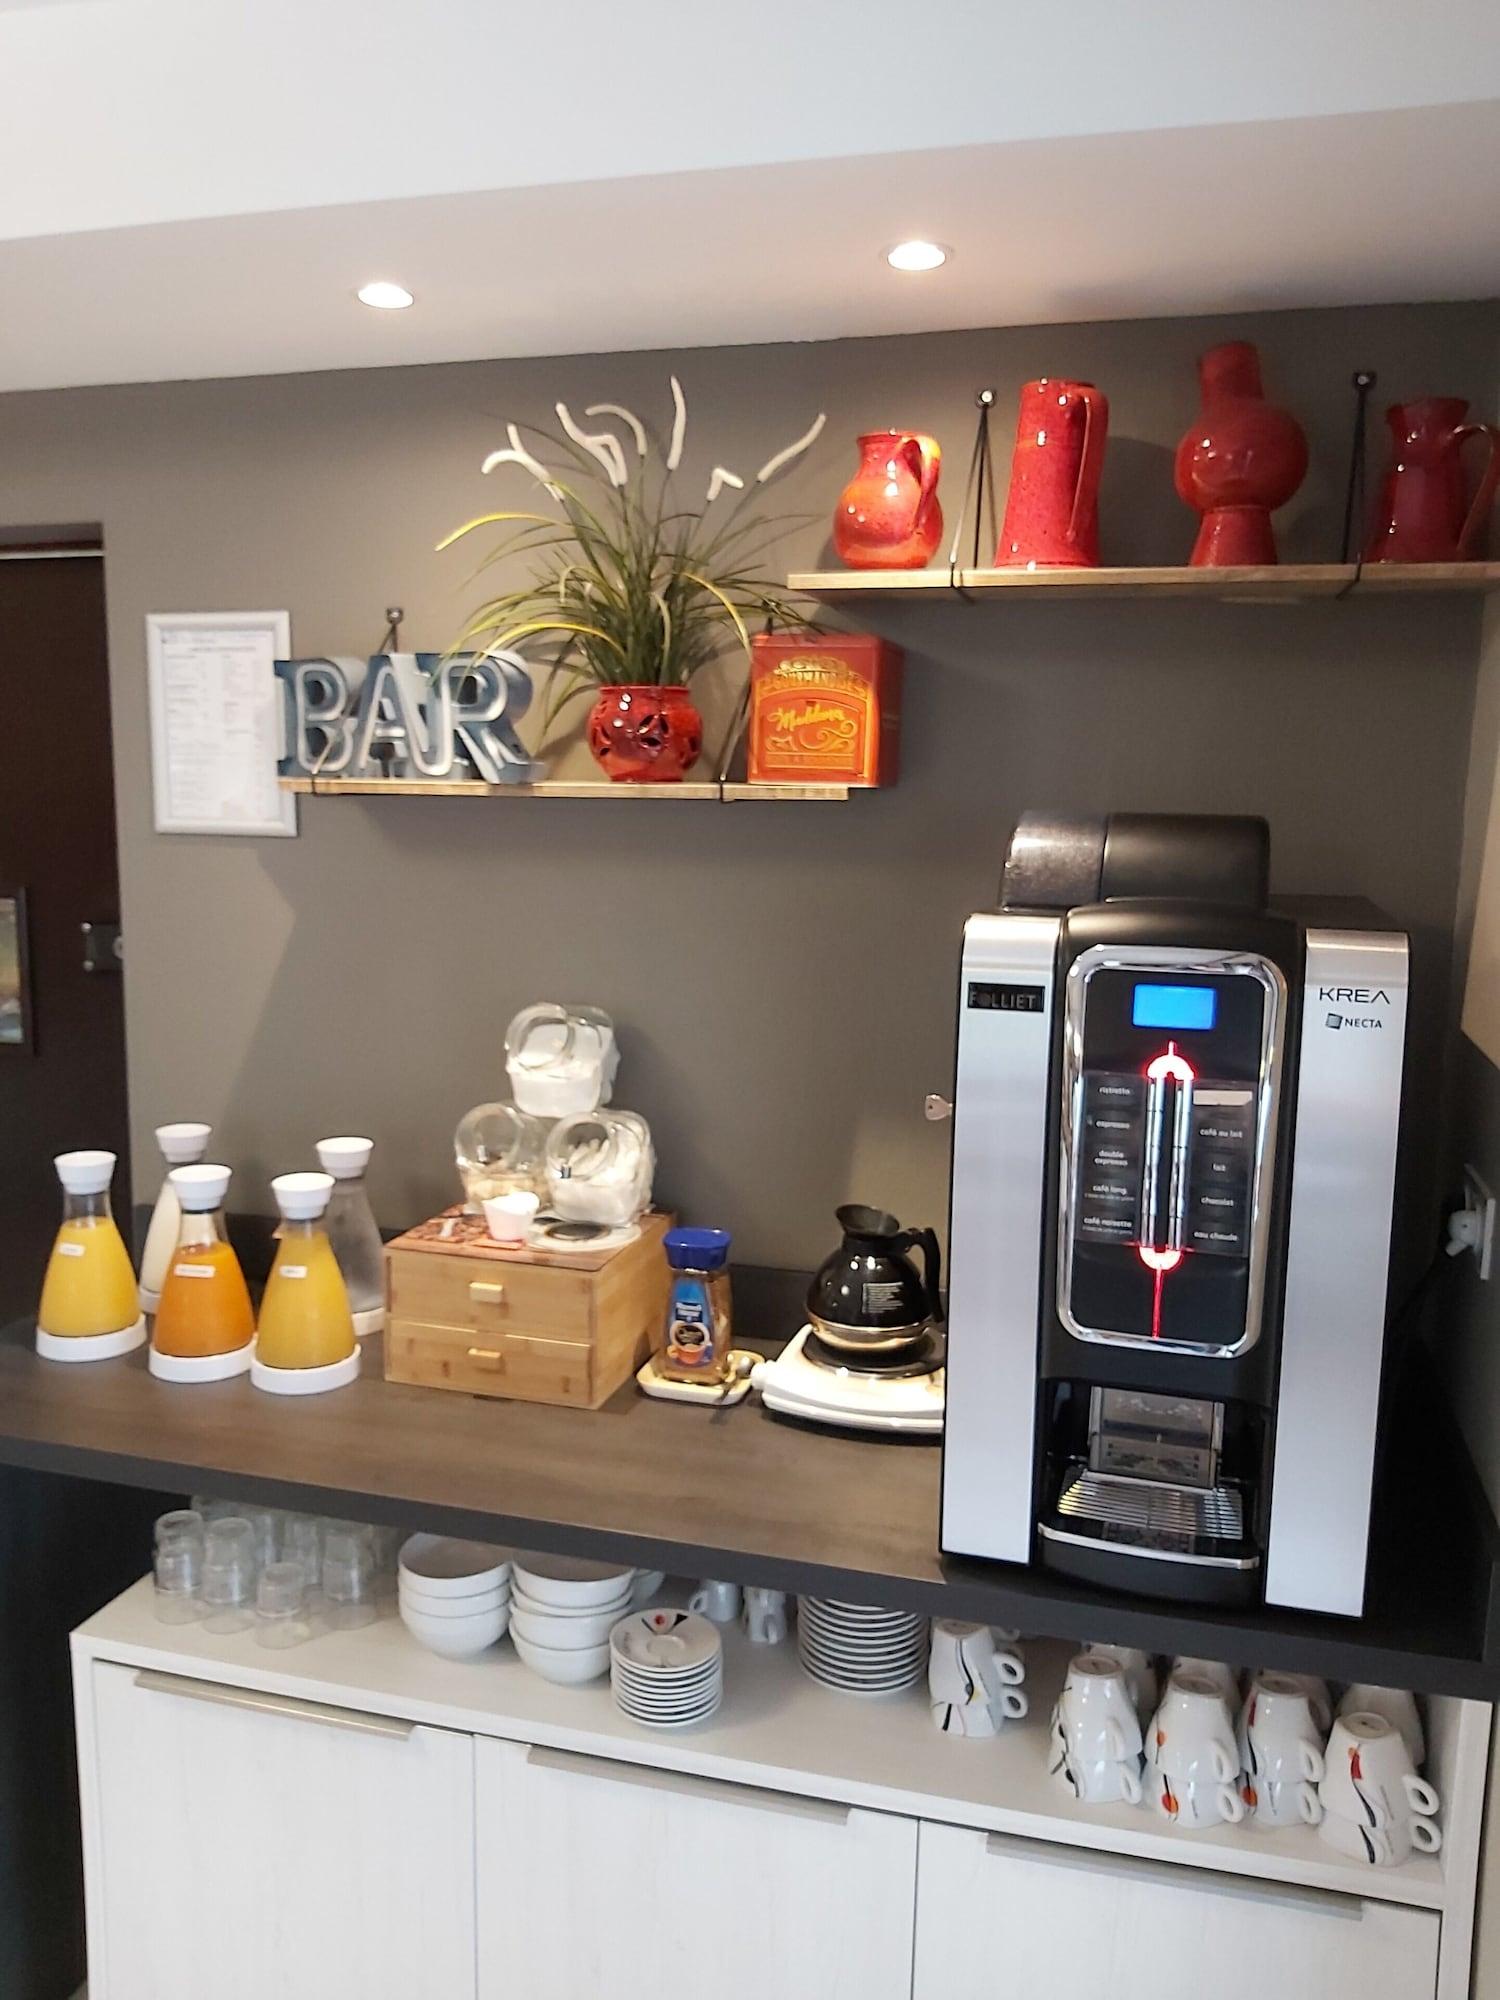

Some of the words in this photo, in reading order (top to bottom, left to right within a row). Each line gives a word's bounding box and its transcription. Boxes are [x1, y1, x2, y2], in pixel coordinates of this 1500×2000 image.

[274, 651, 543, 784] BAR
[969, 991, 1037, 1010] FLLIET
[1320, 987, 1390, 1005] KREA
[1345, 1018, 1382, 1029] NECTA
